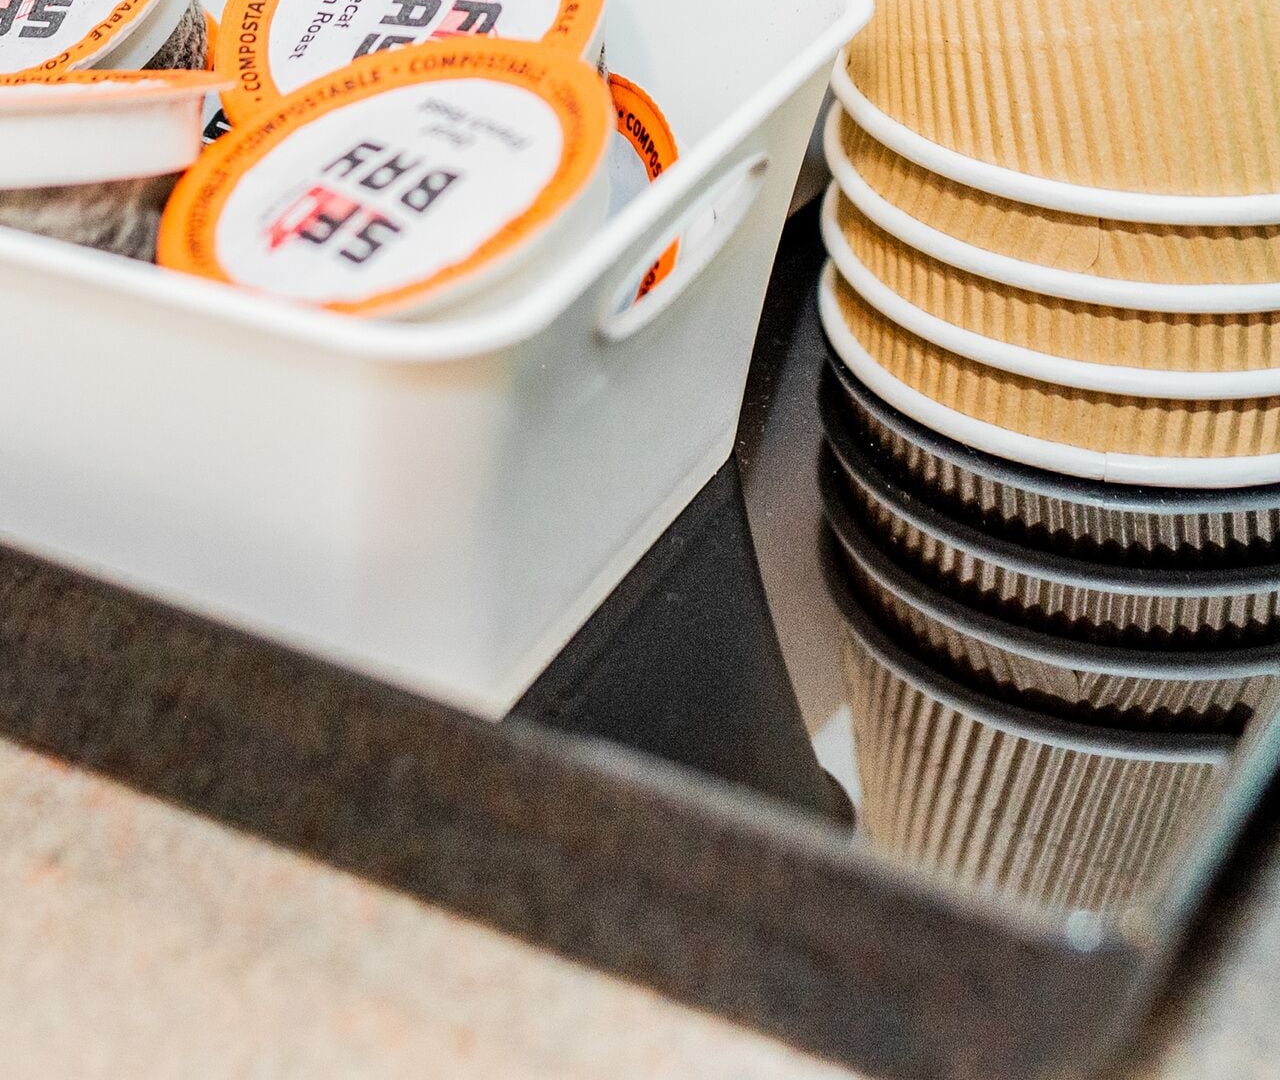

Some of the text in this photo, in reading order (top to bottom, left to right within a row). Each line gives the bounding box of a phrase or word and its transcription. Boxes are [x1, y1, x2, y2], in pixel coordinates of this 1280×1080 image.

[287, 10, 335, 62] Roast
[322, 140, 461, 213] BAY
[625, 112, 663, 178] COMPOS
[298, 204, 402, 265] SF
